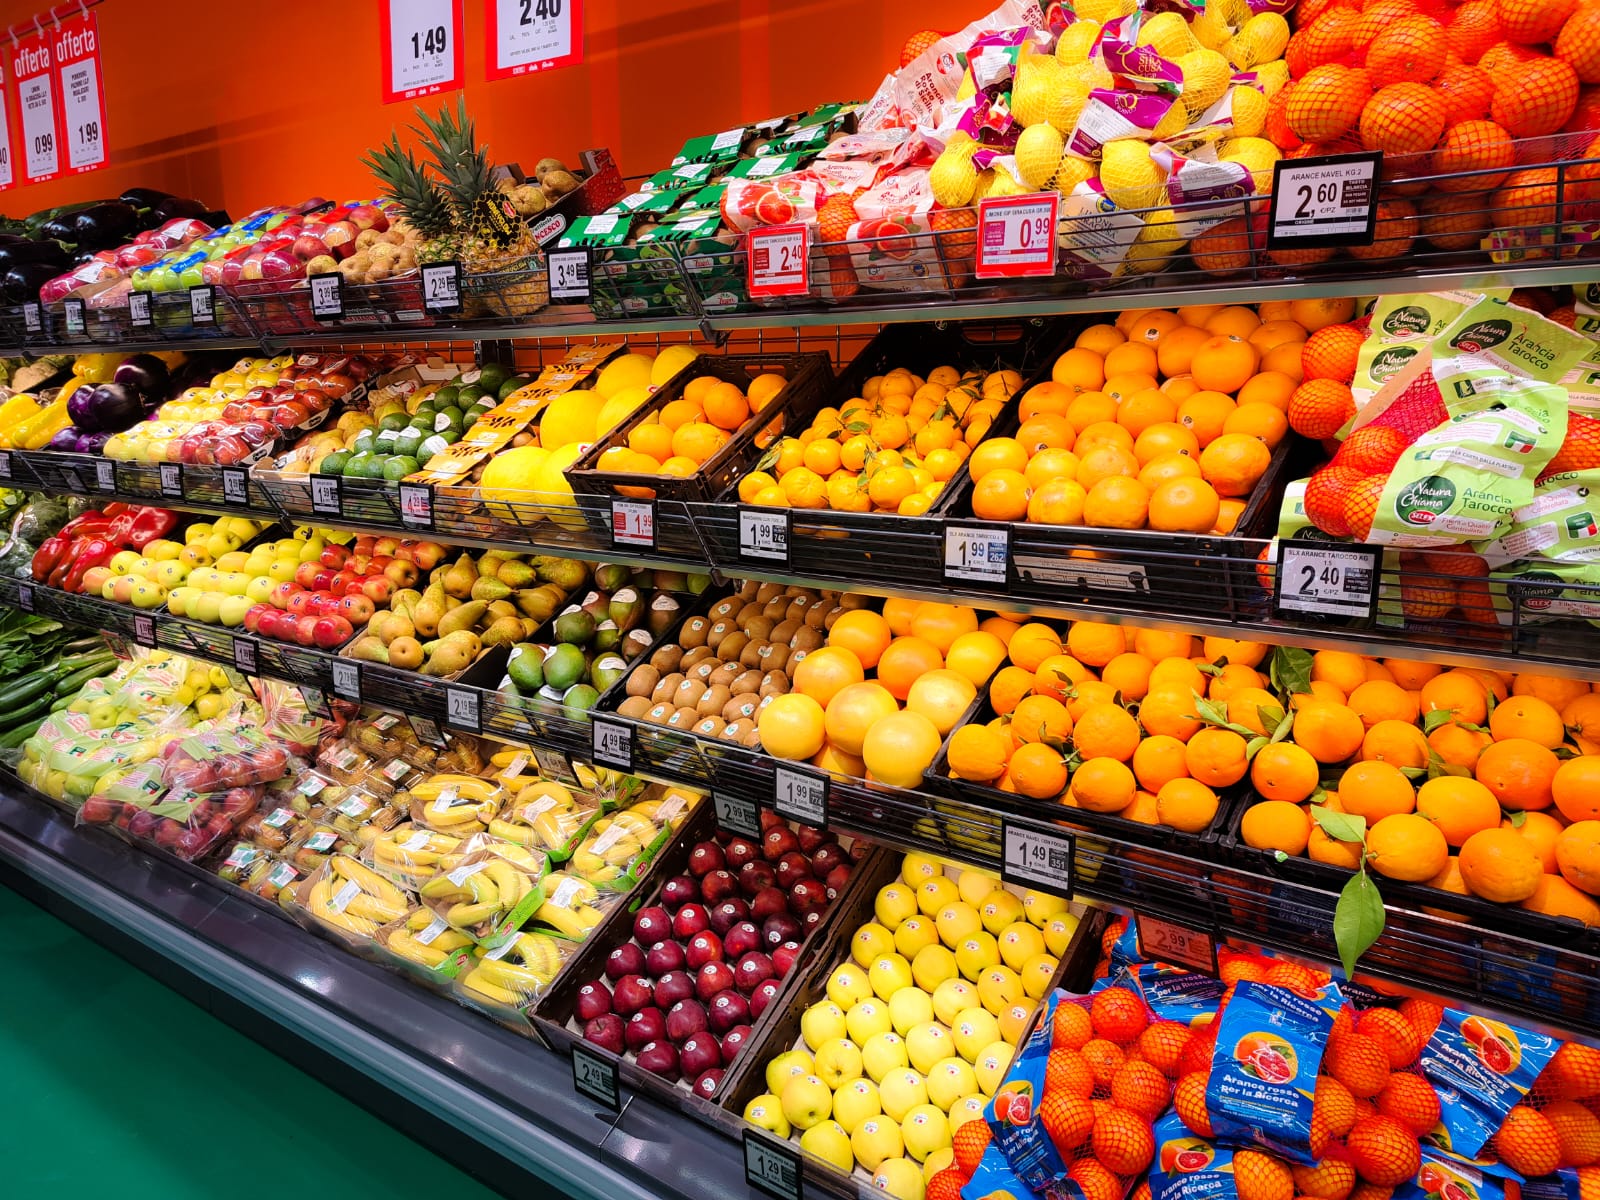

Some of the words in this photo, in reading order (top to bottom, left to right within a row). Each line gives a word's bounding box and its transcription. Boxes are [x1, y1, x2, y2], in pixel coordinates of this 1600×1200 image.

[519, 0, 561, 26] 2,40
[56, 28, 95, 63] offerta
[411, 25, 446, 60] 1,49
[14, 45, 50, 78] offerta
[35, 133, 53, 155] 0,99
[79, 121, 98, 146] 1,99
[1291, 172, 1319, 181] ARANCE
[1321, 170, 1344, 179] NAVEL
[1294, 182, 1337, 219] 2,60
[1019, 217, 1050, 250] 0,99
[780, 244, 803, 273] 2,40
[558, 264, 575, 287] 3,49
[1507, 342, 1549, 370] Tarocco
[1513, 333, 1556, 361] Arancia
[1383, 352, 1415, 367] Natur
[1413, 482, 1453, 499] Natura
[1535, 472, 1579, 489] arocco
[1401, 493, 1443, 508] Chiama
[1462, 498, 1513, 516] Tarocco
[1463, 488, 1512, 504] Arancia
[635, 513, 651, 535] 1,99
[1412, 513, 1434, 522] SELEX
[751, 523, 770, 546] 1,99
[959, 541, 984, 567] 1,99
[990, 552, 1004, 562] 262
[1328, 552, 1357, 561] TAROCCO
[1298, 565, 1340, 597] 2,40
[601, 732, 618, 753] 4,99
[787, 782, 807, 804] 1,99
[1019, 841, 1046, 869] 1,49
[1051, 859, 1066, 870] 351
[1155, 929, 1186, 952] 2,99
[1157, 987, 1171, 999] per
[1340, 984, 1377, 999] Arance
[1281, 997, 1319, 1023] Ricerca
[1293, 997, 1322, 1016] rosse
[582, 1063, 600, 1086] 2,49
[1220, 1085, 1241, 1097] per
[1242, 1087, 1252, 1097] la
[1254, 1090, 1299, 1108] Ricerca
[1223, 1074, 1265, 1092] Arance
[1267, 1085, 1300, 1102] rosse
[757, 1155, 779, 1179] 1,29
[1189, 1173, 1220, 1182] rosse
[1181, 1181, 1223, 1196] Ricerca
